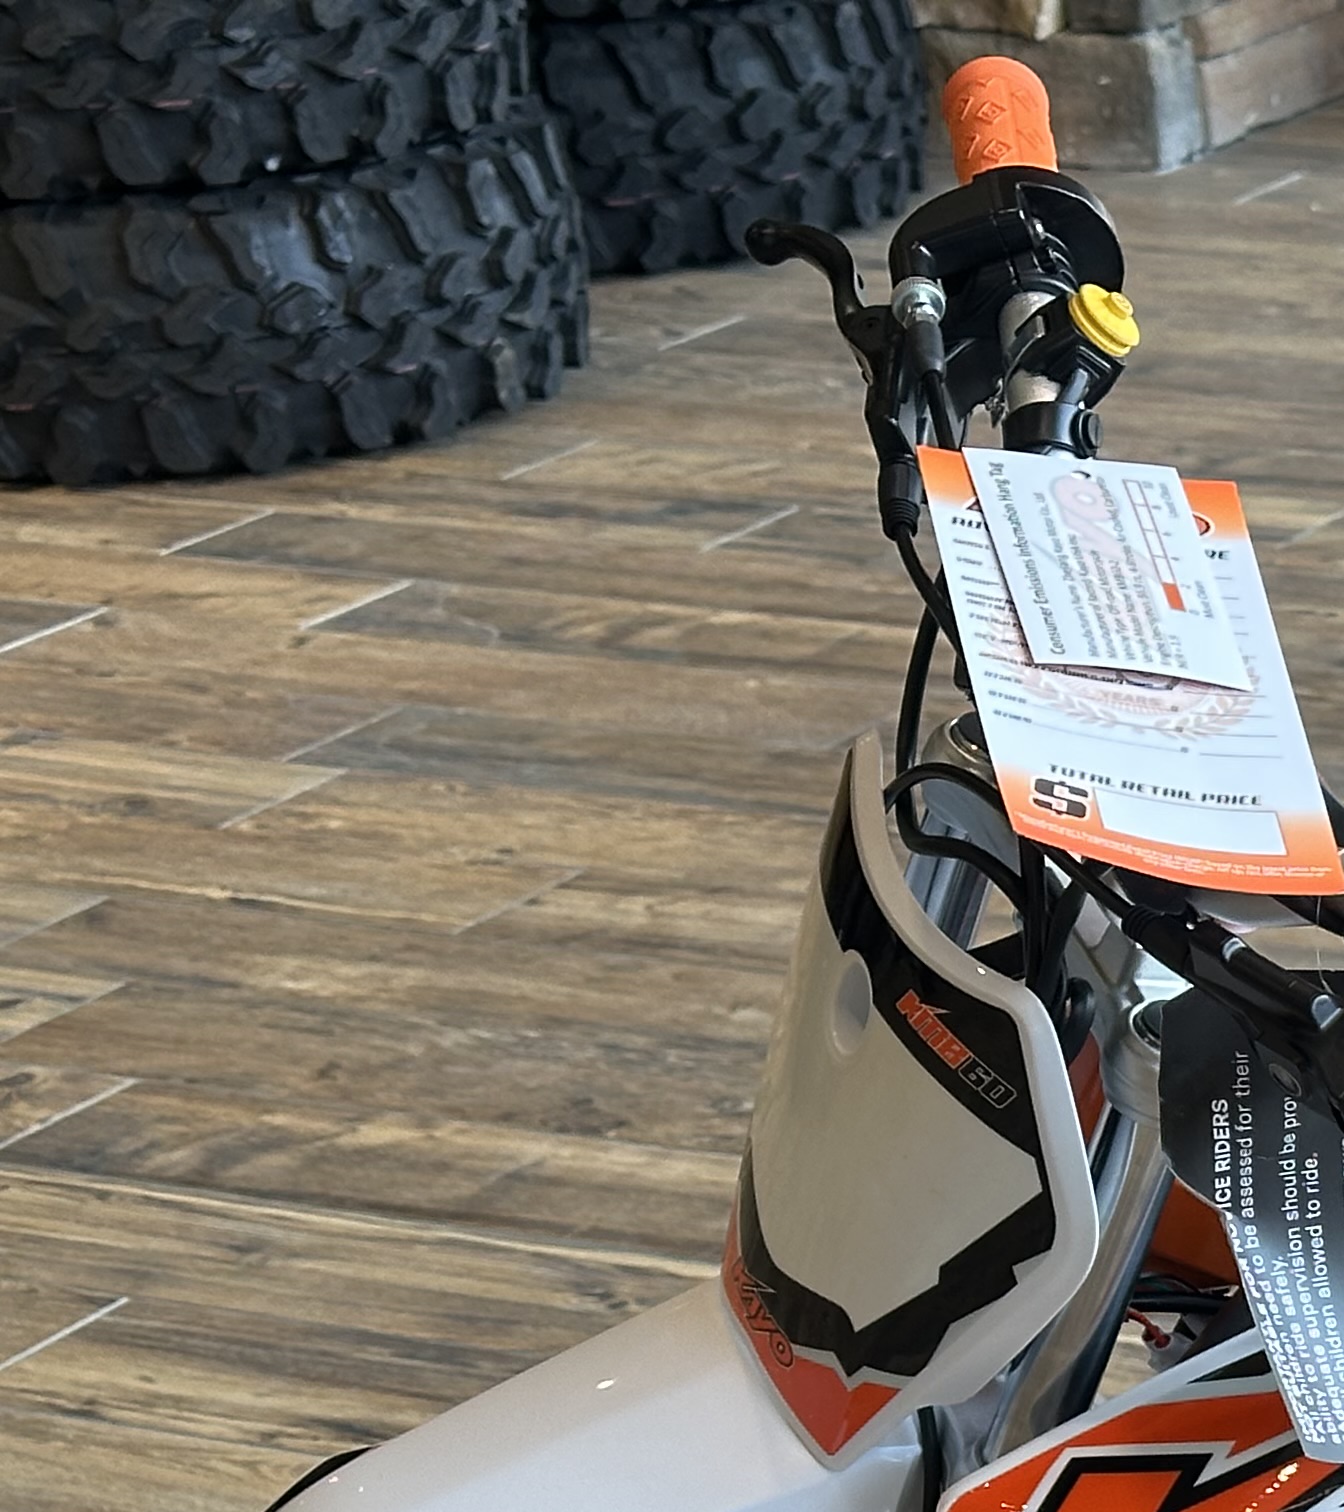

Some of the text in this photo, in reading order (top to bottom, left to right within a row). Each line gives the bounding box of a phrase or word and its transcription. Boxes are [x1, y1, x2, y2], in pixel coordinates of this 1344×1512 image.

[987, 460, 1066, 655] Consumer Emissions Information Hang Tag
[1048, 763, 1263, 807] TOTAL RETAIL PRICE
[1230, 1050, 1251, 1097] their
[1211, 1099, 1231, 1172] RIDERS
[1234, 1103, 1253, 1132] for
[1278, 1132, 1296, 1155] be
[1235, 1137, 1255, 1218] assessed
[1278, 1159, 1300, 1221] should
[1300, 1152, 1320, 1193] ride.
[1305, 1200, 1322, 1219] to
[1244, 1224, 1260, 1249] be
[1252, 1254, 1266, 1274] to
[1287, 1226, 1320, 1339] supervision
[1304, 1225, 1331, 1298] allowed
[1257, 1280, 1284, 1326] need
[1290, 1322, 1311, 1358] ride
[1280, 1332, 1314, 1406] children
[1304, 1363, 1318, 1383] to
[1313, 1388, 1342, 1445] ability
